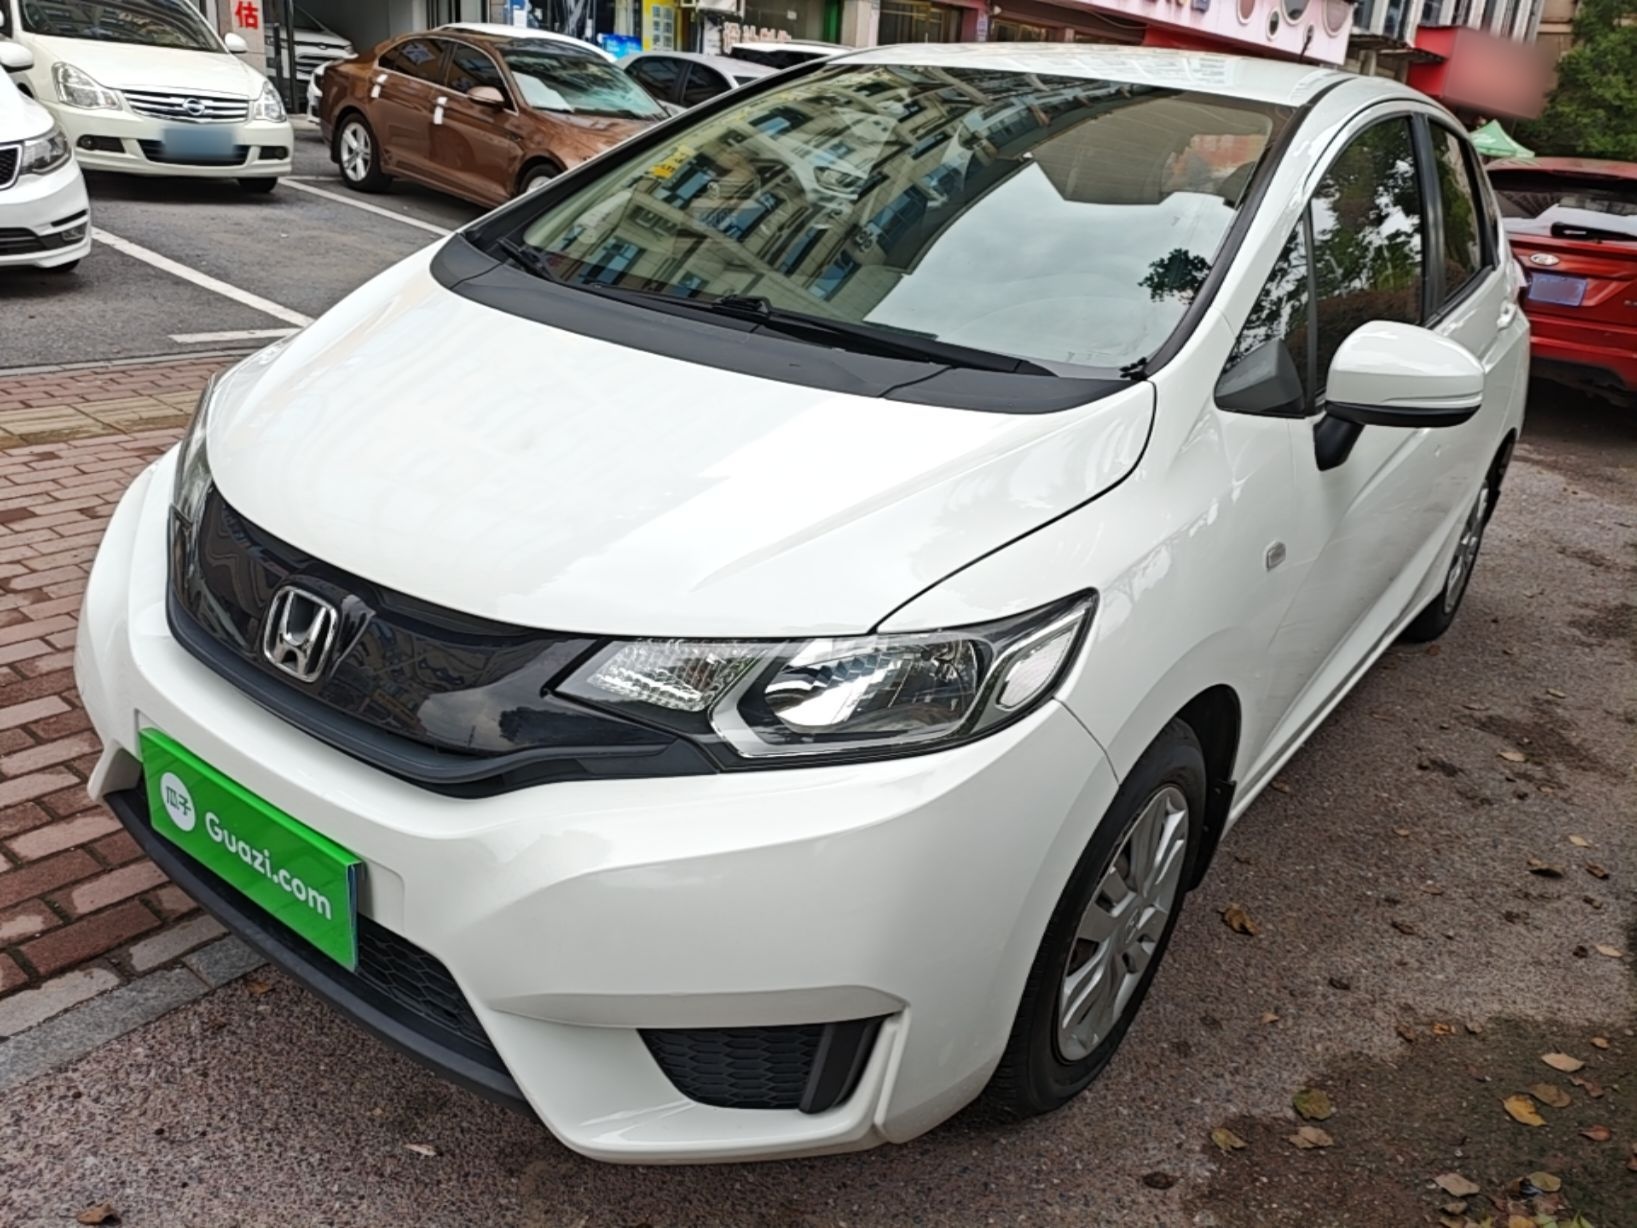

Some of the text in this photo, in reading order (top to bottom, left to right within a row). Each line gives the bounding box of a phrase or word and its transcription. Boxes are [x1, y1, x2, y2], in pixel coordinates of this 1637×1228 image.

[235, 1, 258, 29] 估
[166, 785, 192, 816] 瓜子
[205, 811, 332, 920] Guazi.com
